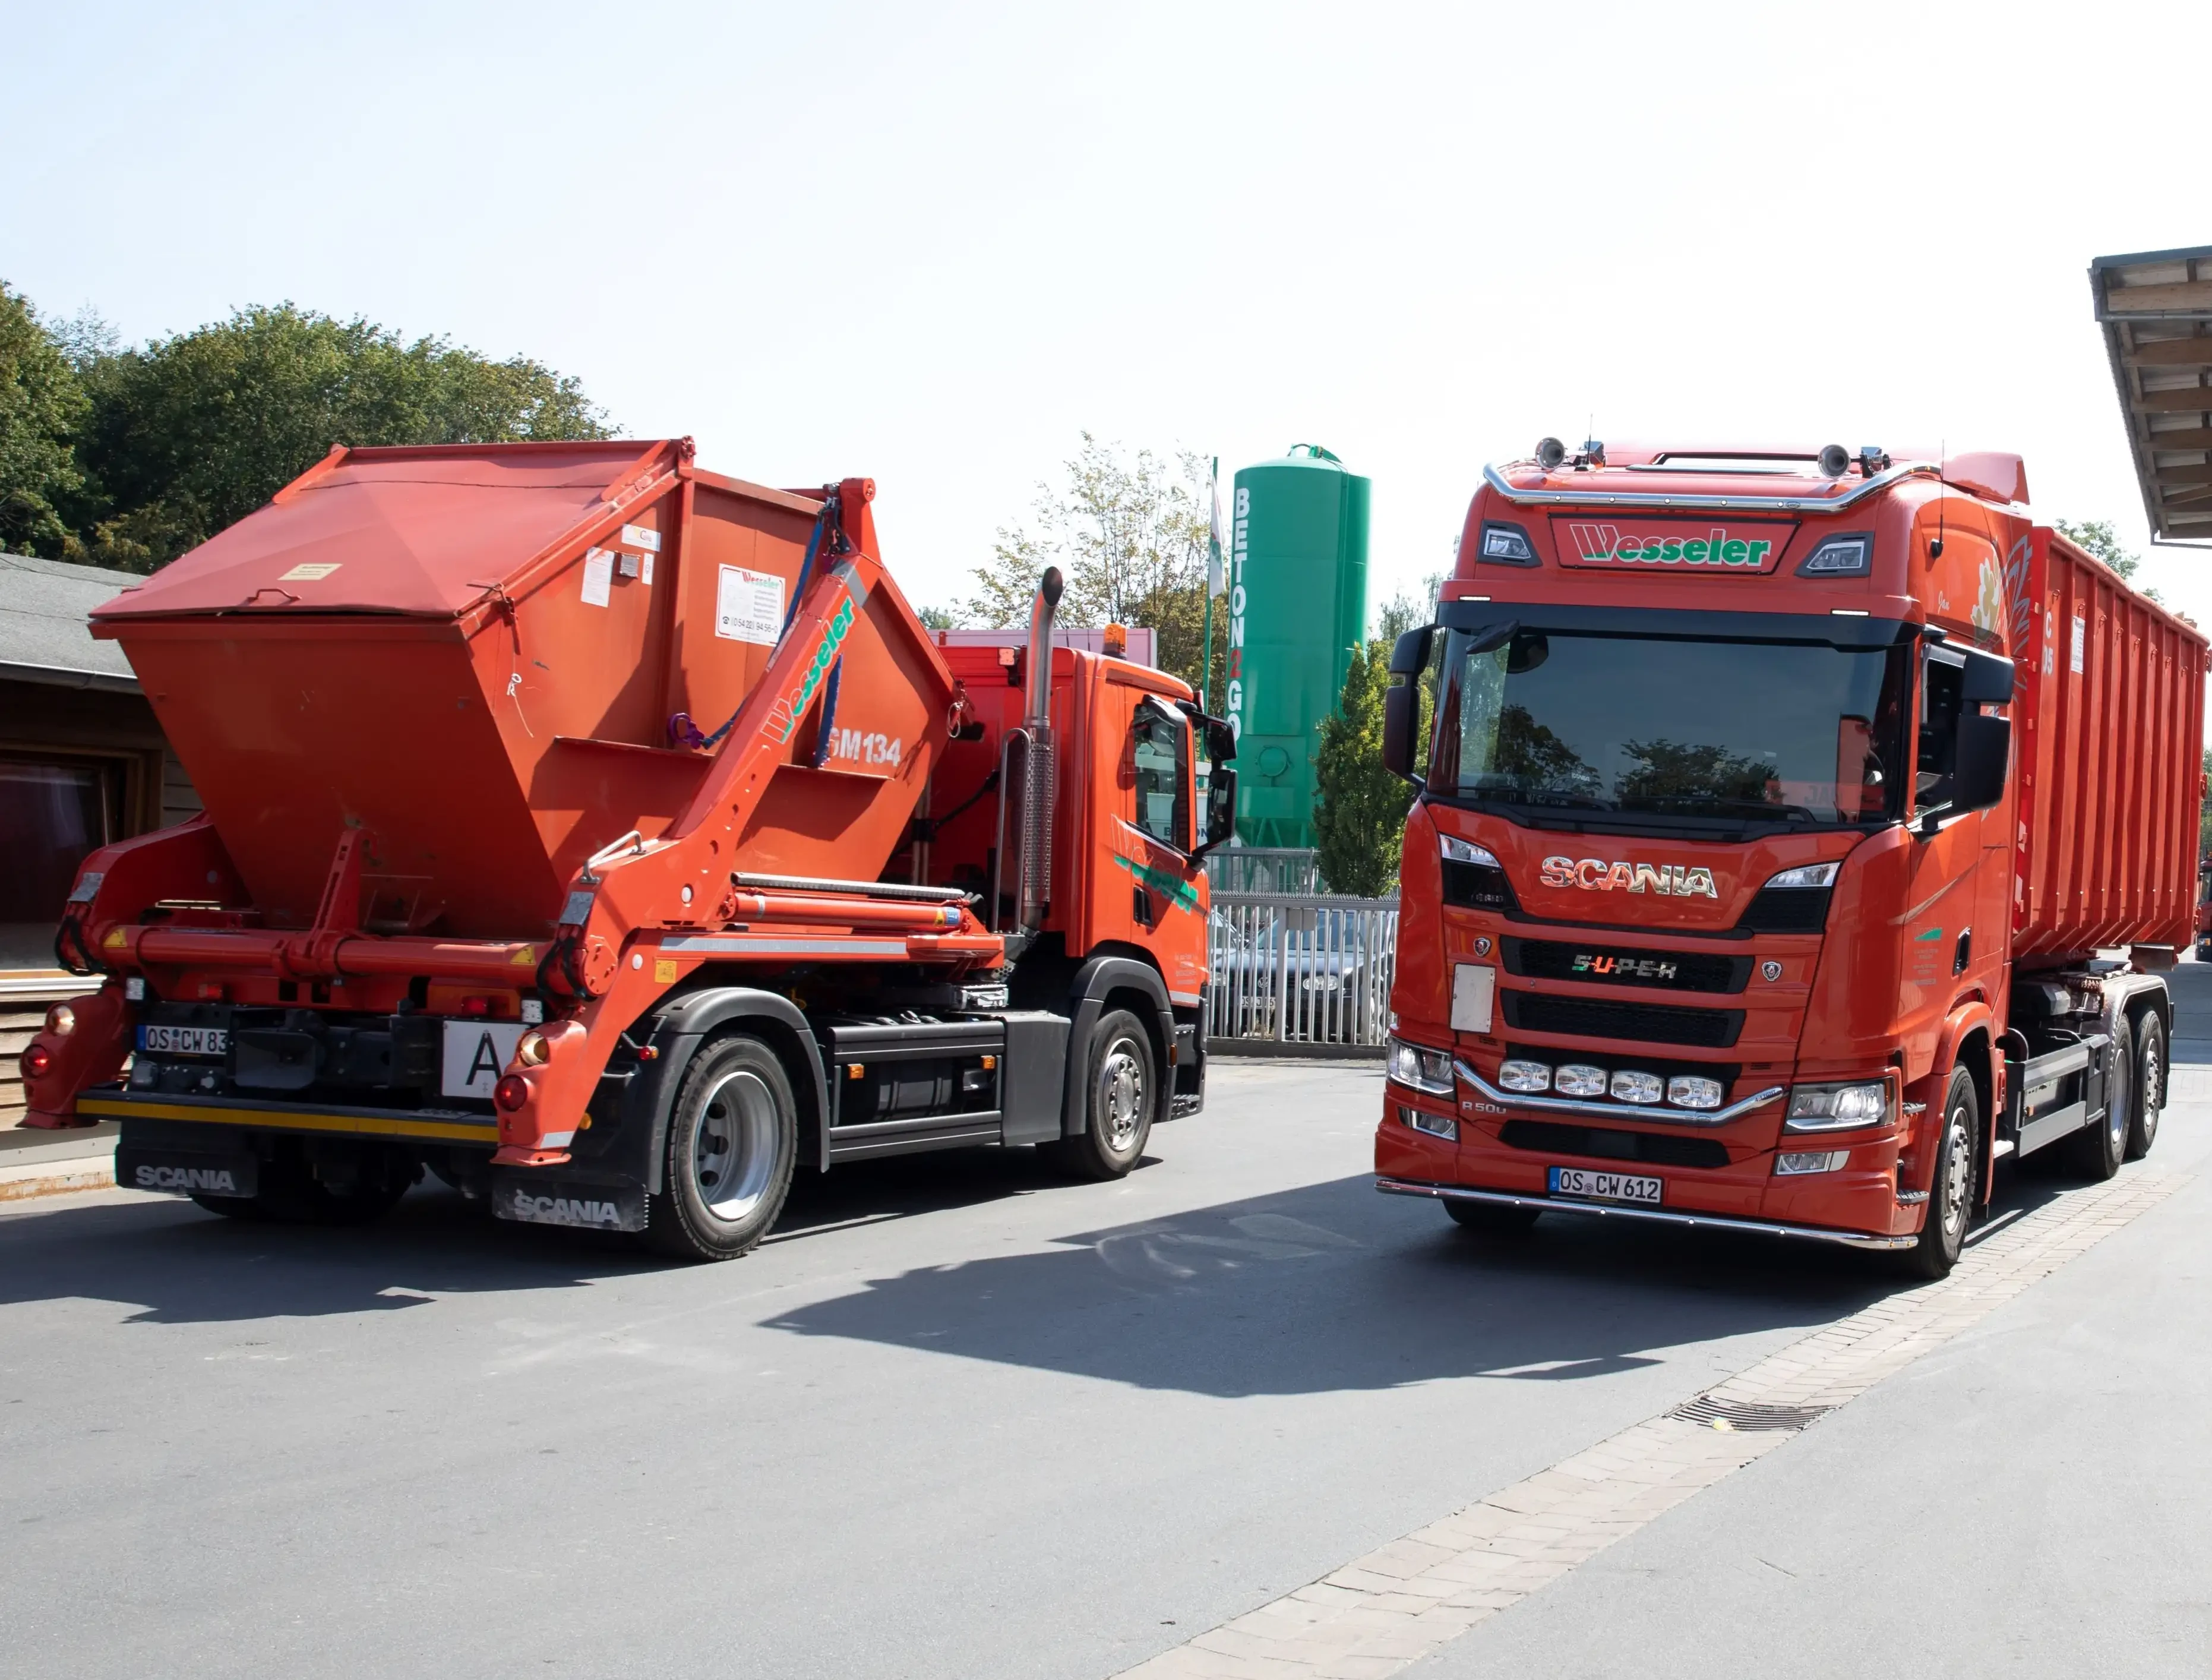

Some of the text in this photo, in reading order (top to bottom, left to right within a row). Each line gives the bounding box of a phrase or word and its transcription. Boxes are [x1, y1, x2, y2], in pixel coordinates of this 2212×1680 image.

[1569, 523, 1772, 567] Wesseler
[760, 595, 856, 744] Wesseler
[1540, 856, 1718, 899] SCANIA
[1572, 955, 1677, 979] SUPER
[147, 1028, 170, 1050] OS
[181, 1030, 204, 1051] CW
[465, 1032, 503, 1086] A
[1462, 1101, 1472, 1110] R
[135, 1165, 236, 1191] SCANIA
[1560, 1171, 1584, 1192] OS
[1596, 1175, 1620, 1196] CW
[1623, 1178, 1659, 1200] 612
[513, 1193, 621, 1224] SCANIA
